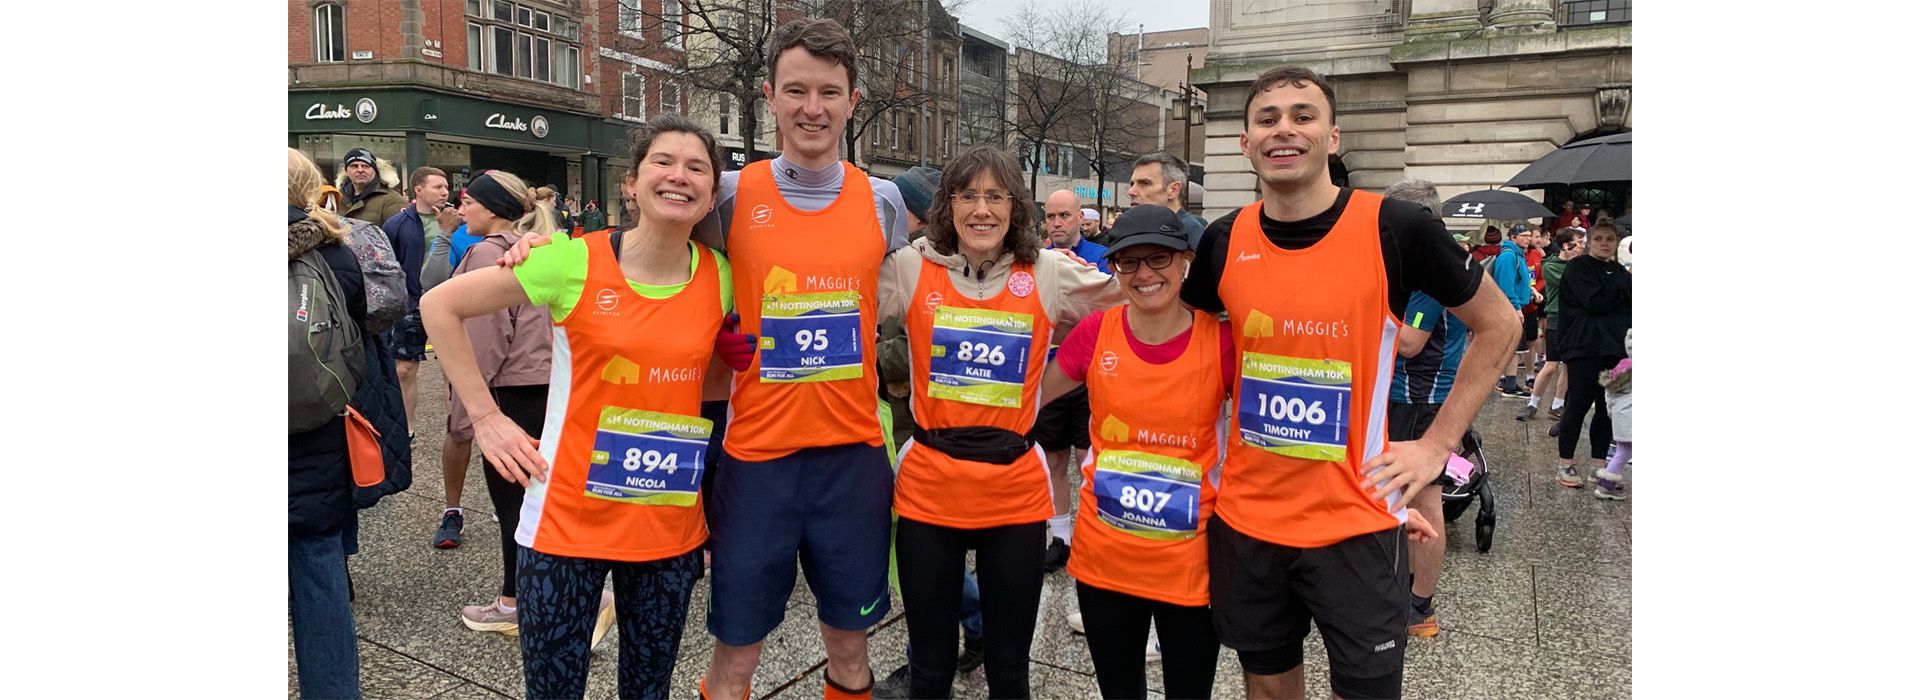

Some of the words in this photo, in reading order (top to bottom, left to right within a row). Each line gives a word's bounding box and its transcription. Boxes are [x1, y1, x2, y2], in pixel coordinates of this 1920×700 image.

[305, 103, 351, 119] Clarks
[485, 113, 527, 131] Clarks
[732, 152, 745, 162] RUS
[1074, 185, 1112, 200] PRIMRK
[806, 274, 860, 291] MAGGIE'S
[780, 301, 839, 310] NOTTINGHAM
[839, 299, 855, 307] 10K
[954, 315, 1012, 328] NOTTINGHAM
[1283, 319, 1349, 338] MAGGIE'S
[795, 329, 828, 351] 95
[801, 356, 826, 366] NICK
[957, 341, 1006, 366] 826
[965, 366, 992, 378] KATIE
[1259, 363, 1324, 378] NOTTINGHAM
[1325, 370, 1344, 379] 10K
[1258, 393, 1326, 425] 1006
[623, 416, 689, 433] NOTTINGHAM
[689, 425, 706, 434] 10K
[1263, 423, 1311, 440] TIMOTHY
[1137, 430, 1197, 448] MAGGIE'S
[623, 448, 677, 475] 894
[1117, 456, 1181, 475] NOTTINGHAM
[1180, 466, 1197, 478] 10K
[626, 476, 666, 489] NICOLA
[1120, 486, 1172, 513] 807
[1122, 511, 1167, 527] JOANNA
